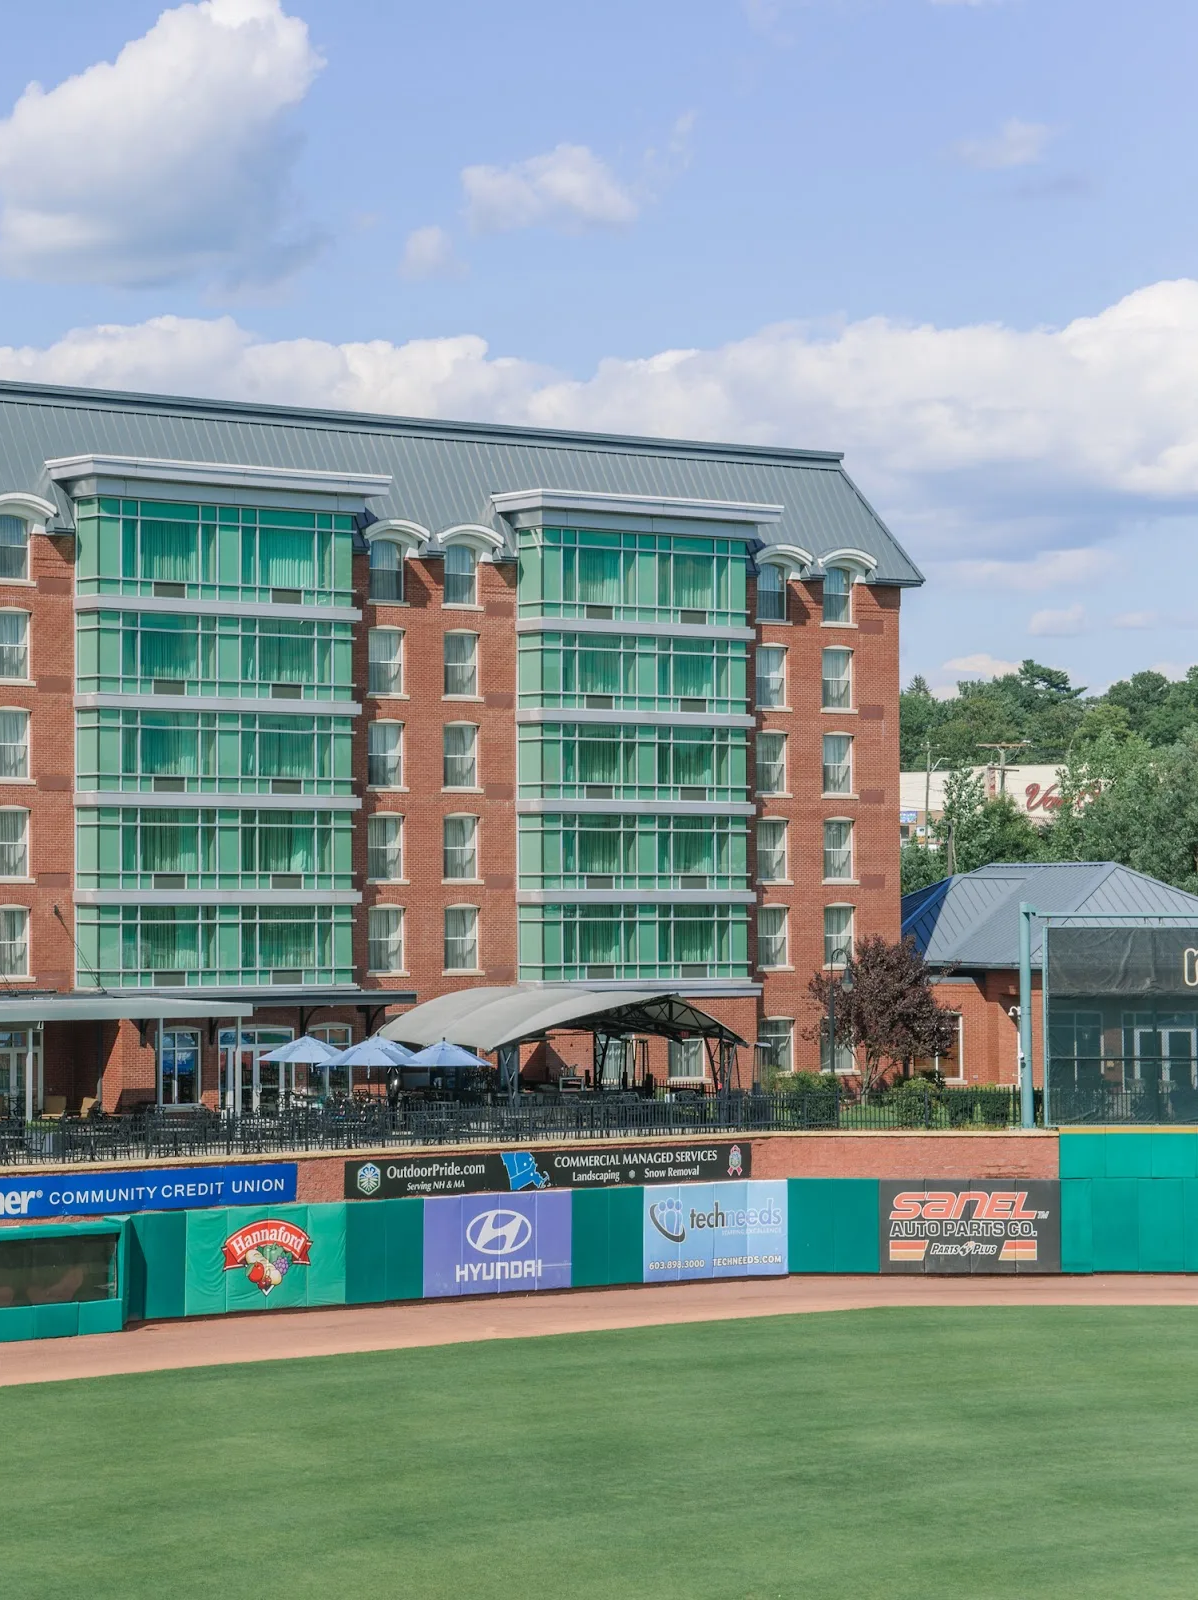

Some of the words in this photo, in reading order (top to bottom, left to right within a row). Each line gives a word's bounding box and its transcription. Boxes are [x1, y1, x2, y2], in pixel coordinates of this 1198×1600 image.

[554, 1154, 621, 1168] COMMERCIAL
[622, 1151, 674, 1165] MANAGED
[675, 1149, 718, 1163] SERVICES
[386, 1162, 486, 1179] OutdoorPride.com
[572, 1170, 620, 1182] Landscaping
[644, 1167, 667, 1178] Snow
[667, 1164, 700, 1177] Removal
[49, 1185, 157, 1205] COMMUNITY
[161, 1181, 225, 1198] CREDIT
[231, 1178, 285, 1194] UNION
[406, 1181, 432, 1192] Serving
[432, 1180, 445, 1190] NH
[446, 1180, 453, 1189] &
[453, 1179, 466, 1189] MA
[689, 1198, 783, 1231] techneeds
[889, 1220, 941, 1237] AUTO
[942, 1220, 1004, 1237] PARTS
[1007, 1220, 1038, 1237] CO.
[230, 1226, 306, 1256] Hannaford
[713, 1255, 783, 1268] TECHNEEDS.COM
[455, 1259, 542, 1283] HYUNDAI
